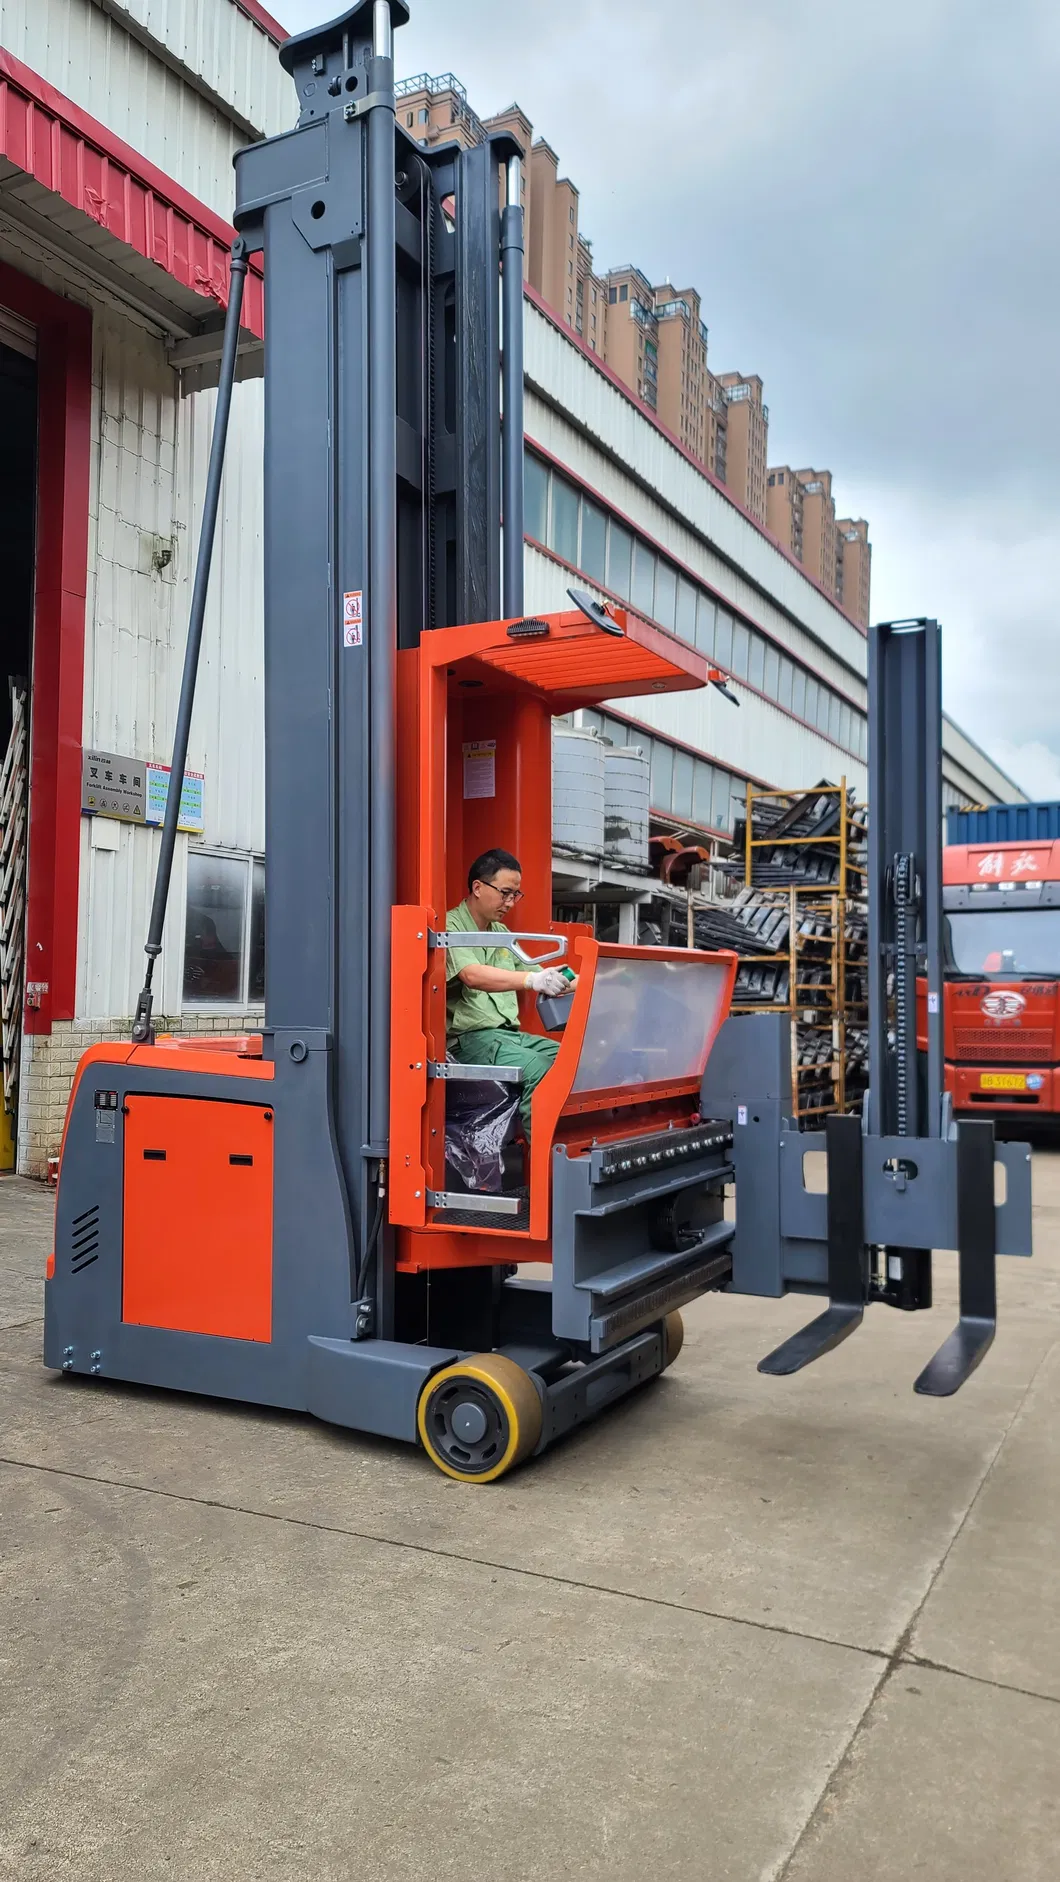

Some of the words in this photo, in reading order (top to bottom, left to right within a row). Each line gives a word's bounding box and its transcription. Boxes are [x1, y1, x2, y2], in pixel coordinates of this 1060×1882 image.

[90, 767, 141, 788] 叉车车间
[86, 781, 102, 790] Forklift
[102, 785, 123, 794] Assembly
[123, 789, 143, 798] Workshop
